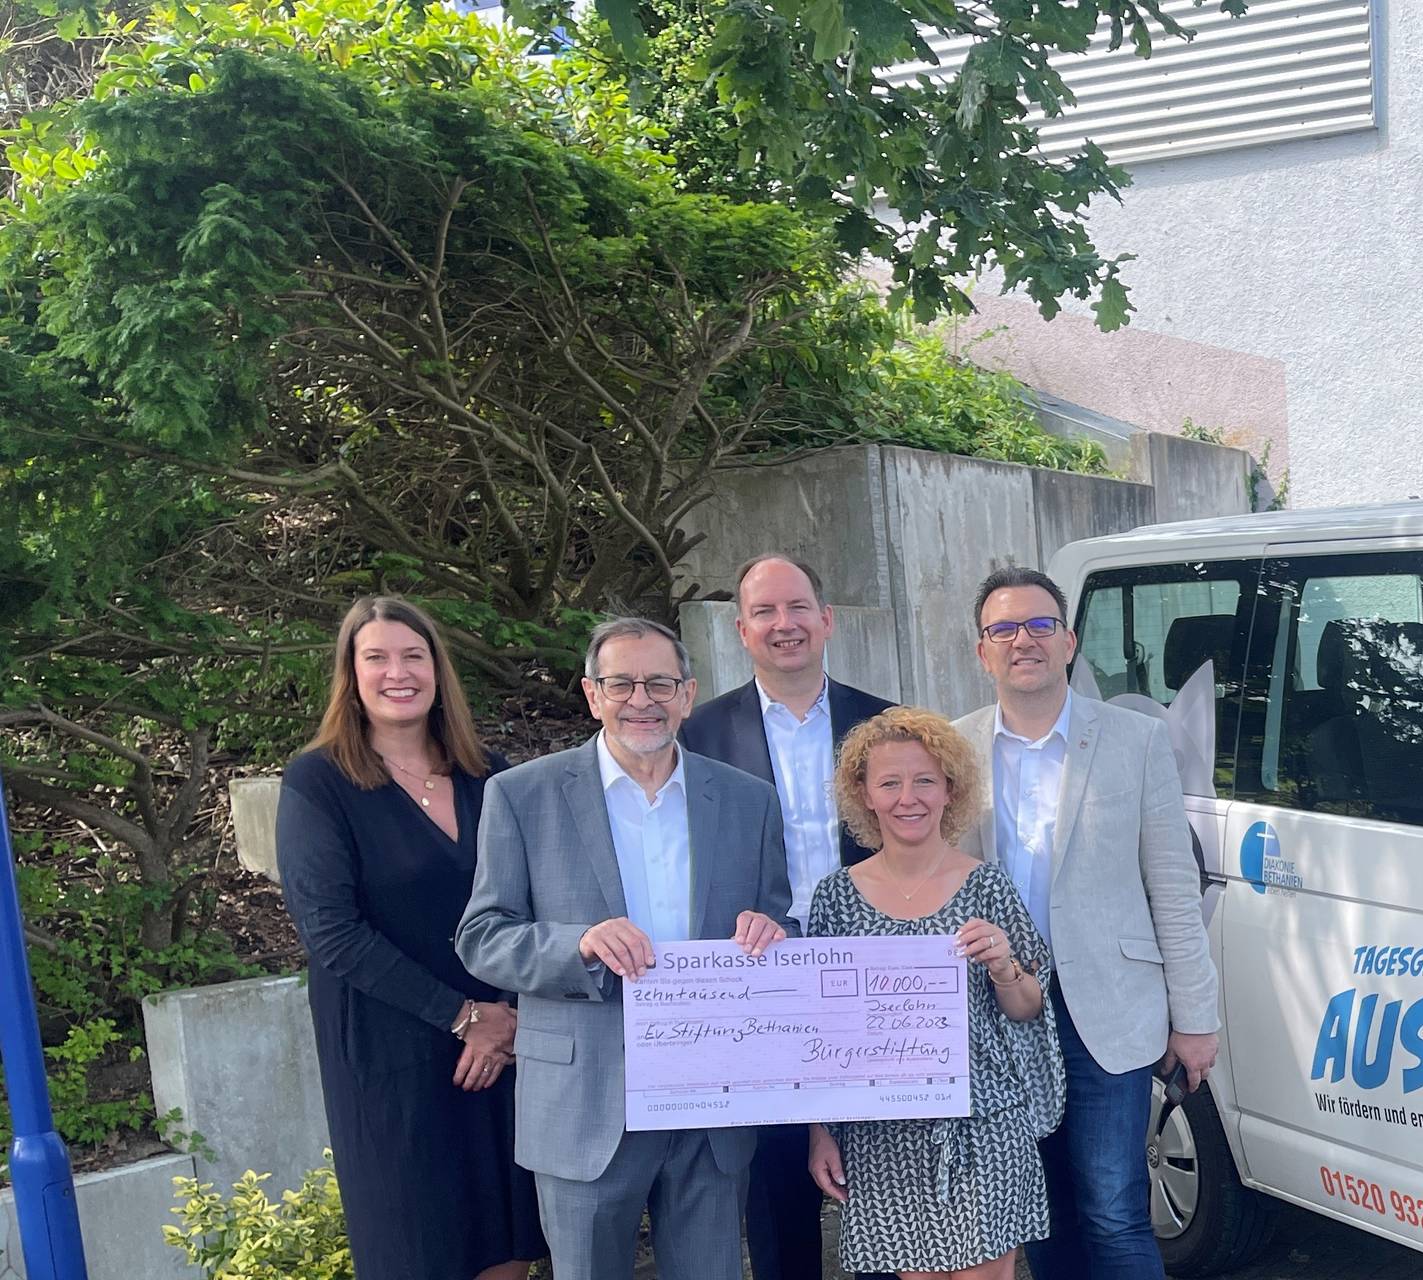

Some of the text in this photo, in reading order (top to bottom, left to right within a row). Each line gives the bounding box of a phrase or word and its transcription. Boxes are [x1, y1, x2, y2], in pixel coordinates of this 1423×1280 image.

[1264, 857, 1296, 875] DIAKONIE
[1264, 870, 1304, 889] BETHANIEN
[663, 948, 854, 973] Sparkasse Iserlohn
[830, 979, 848, 988] EUR
[1315, 1092, 1336, 1114] Wir
[1338, 1096, 1382, 1122] fördern
[1384, 1107, 1408, 1126] und
[1320, 1166, 1386, 1215] 01520
